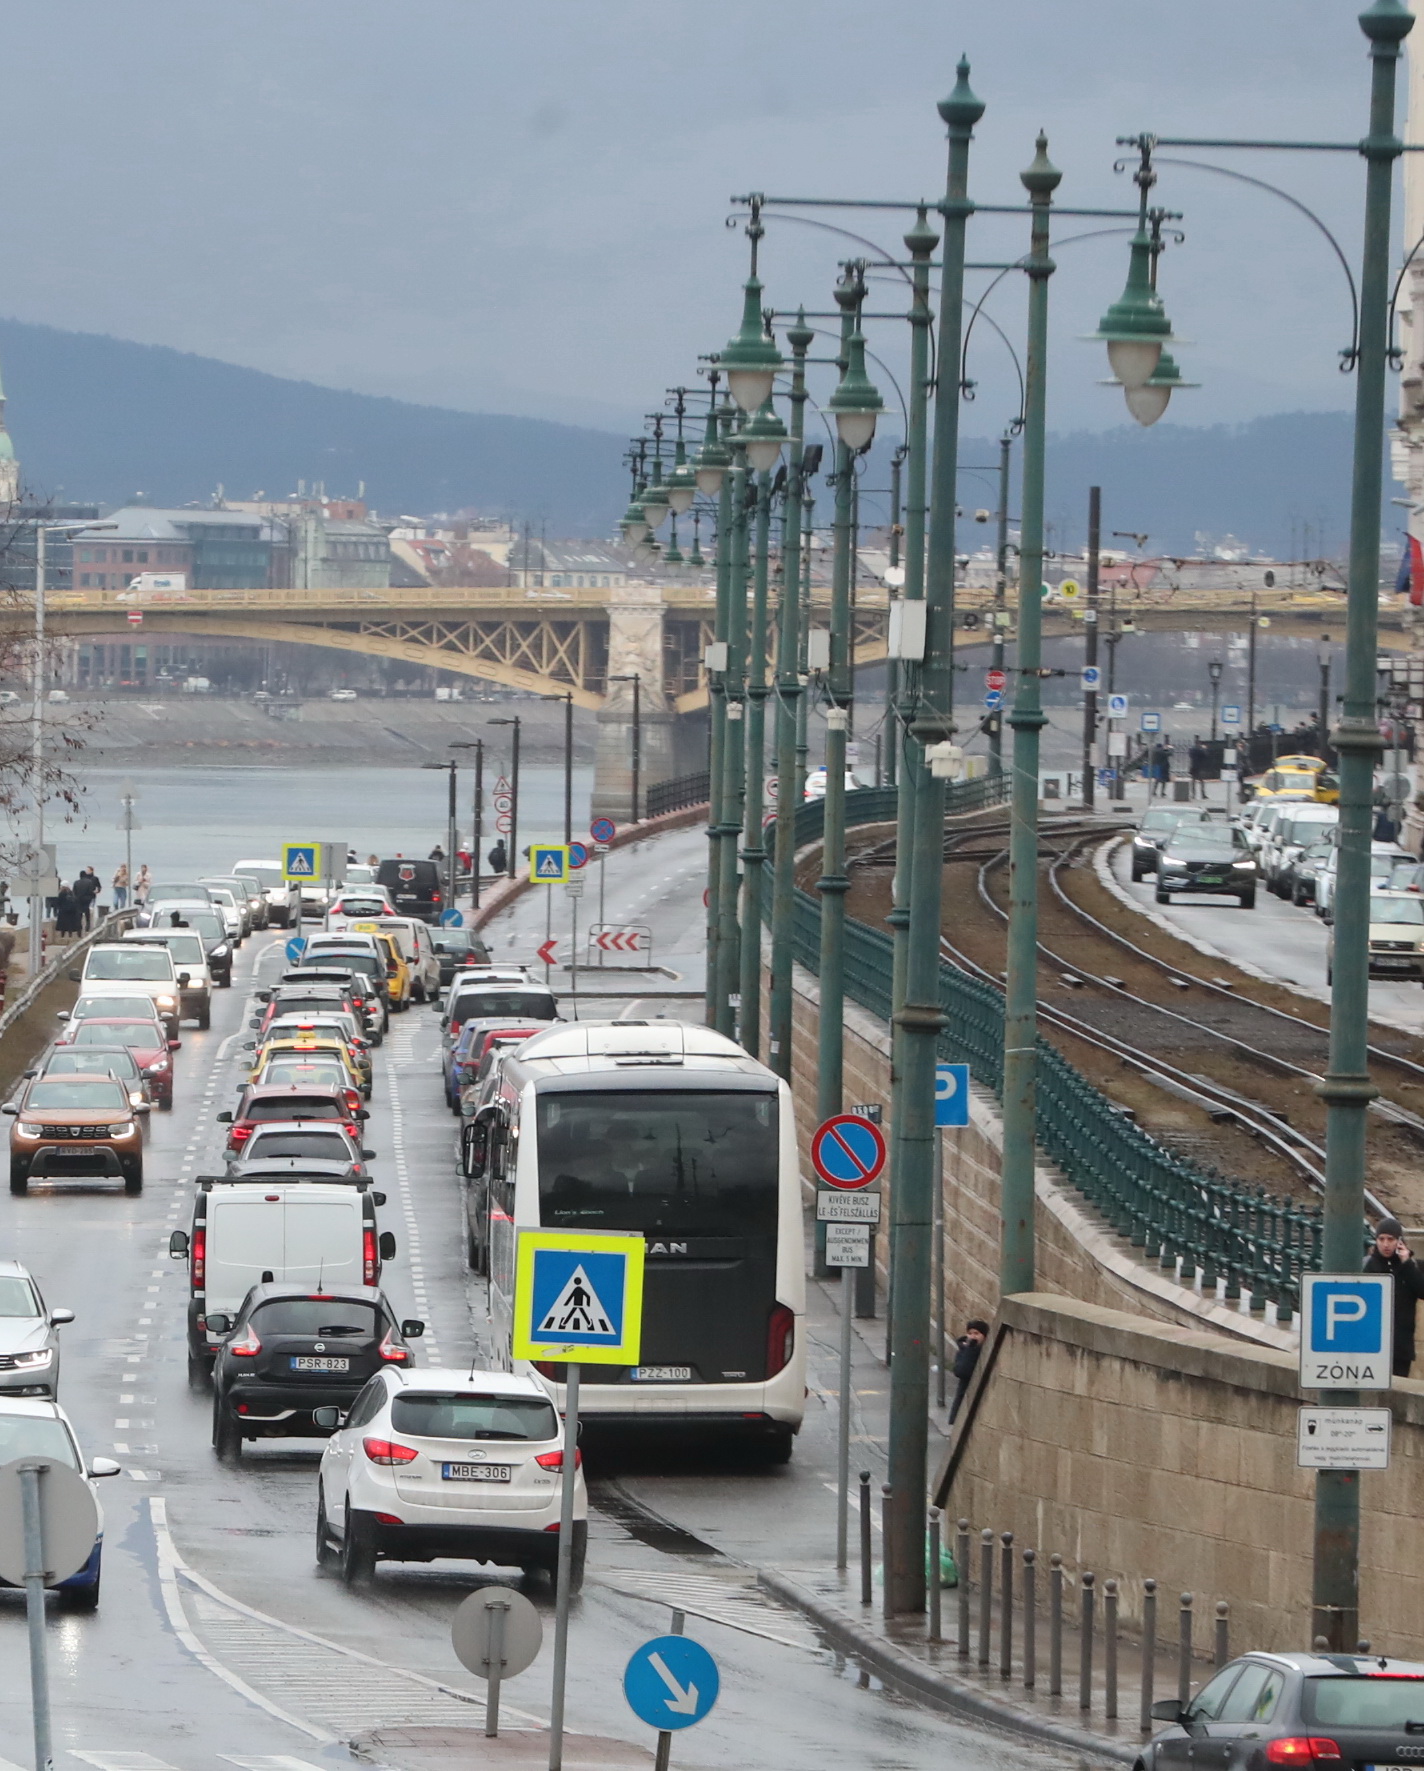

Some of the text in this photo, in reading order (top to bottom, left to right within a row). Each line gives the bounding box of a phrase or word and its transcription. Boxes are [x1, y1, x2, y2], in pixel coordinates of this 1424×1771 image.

[829, 1195, 869, 1205] KIVÉVE BUSZ
[644, 1243, 687, 1253] AN
[1326, 1294, 1367, 1341] P
[298, 1358, 347, 1369] PSR-823
[639, 1368, 688, 1378] PZZ-100
[1316, 1361, 1375, 1380] ZÓNA
[451, 1467, 507, 1479] MBE-306
